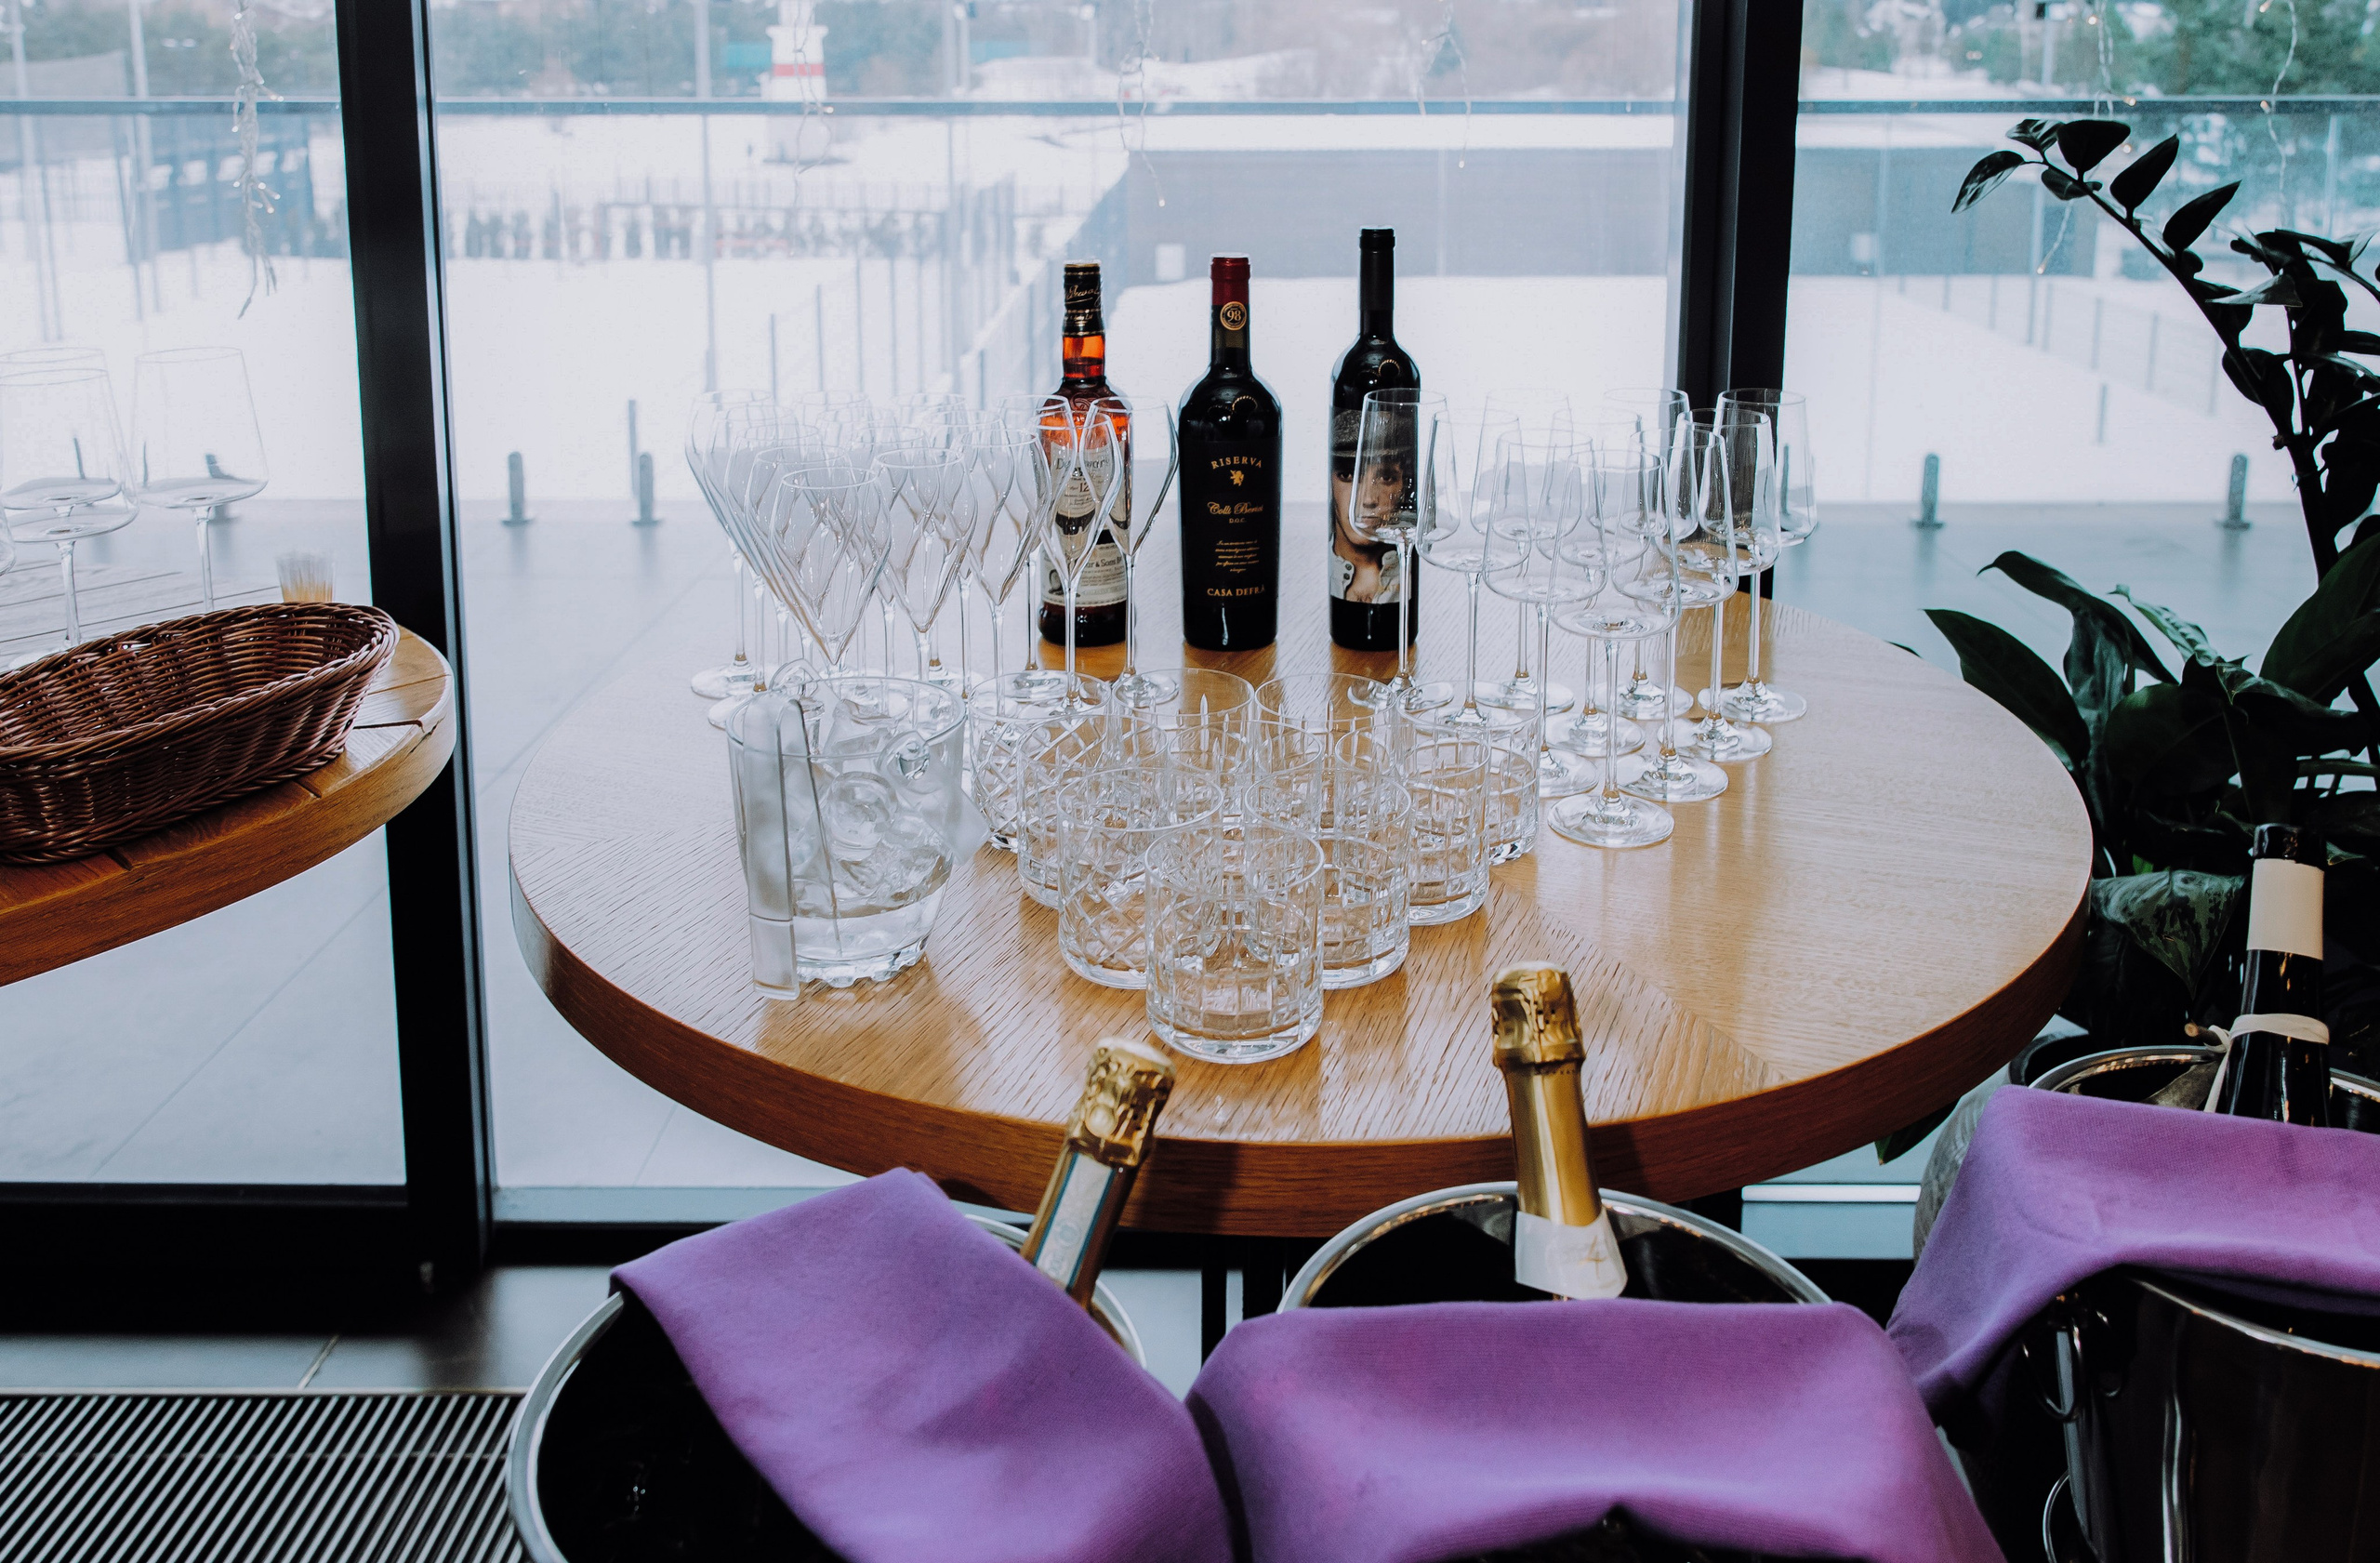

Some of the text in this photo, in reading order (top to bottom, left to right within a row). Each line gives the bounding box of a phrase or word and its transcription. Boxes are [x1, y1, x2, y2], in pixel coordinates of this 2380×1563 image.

[1226, 310, 1242, 322] 98
[1210, 457, 1262, 469] RISERVA
[1207, 588, 1233, 597] CASA
